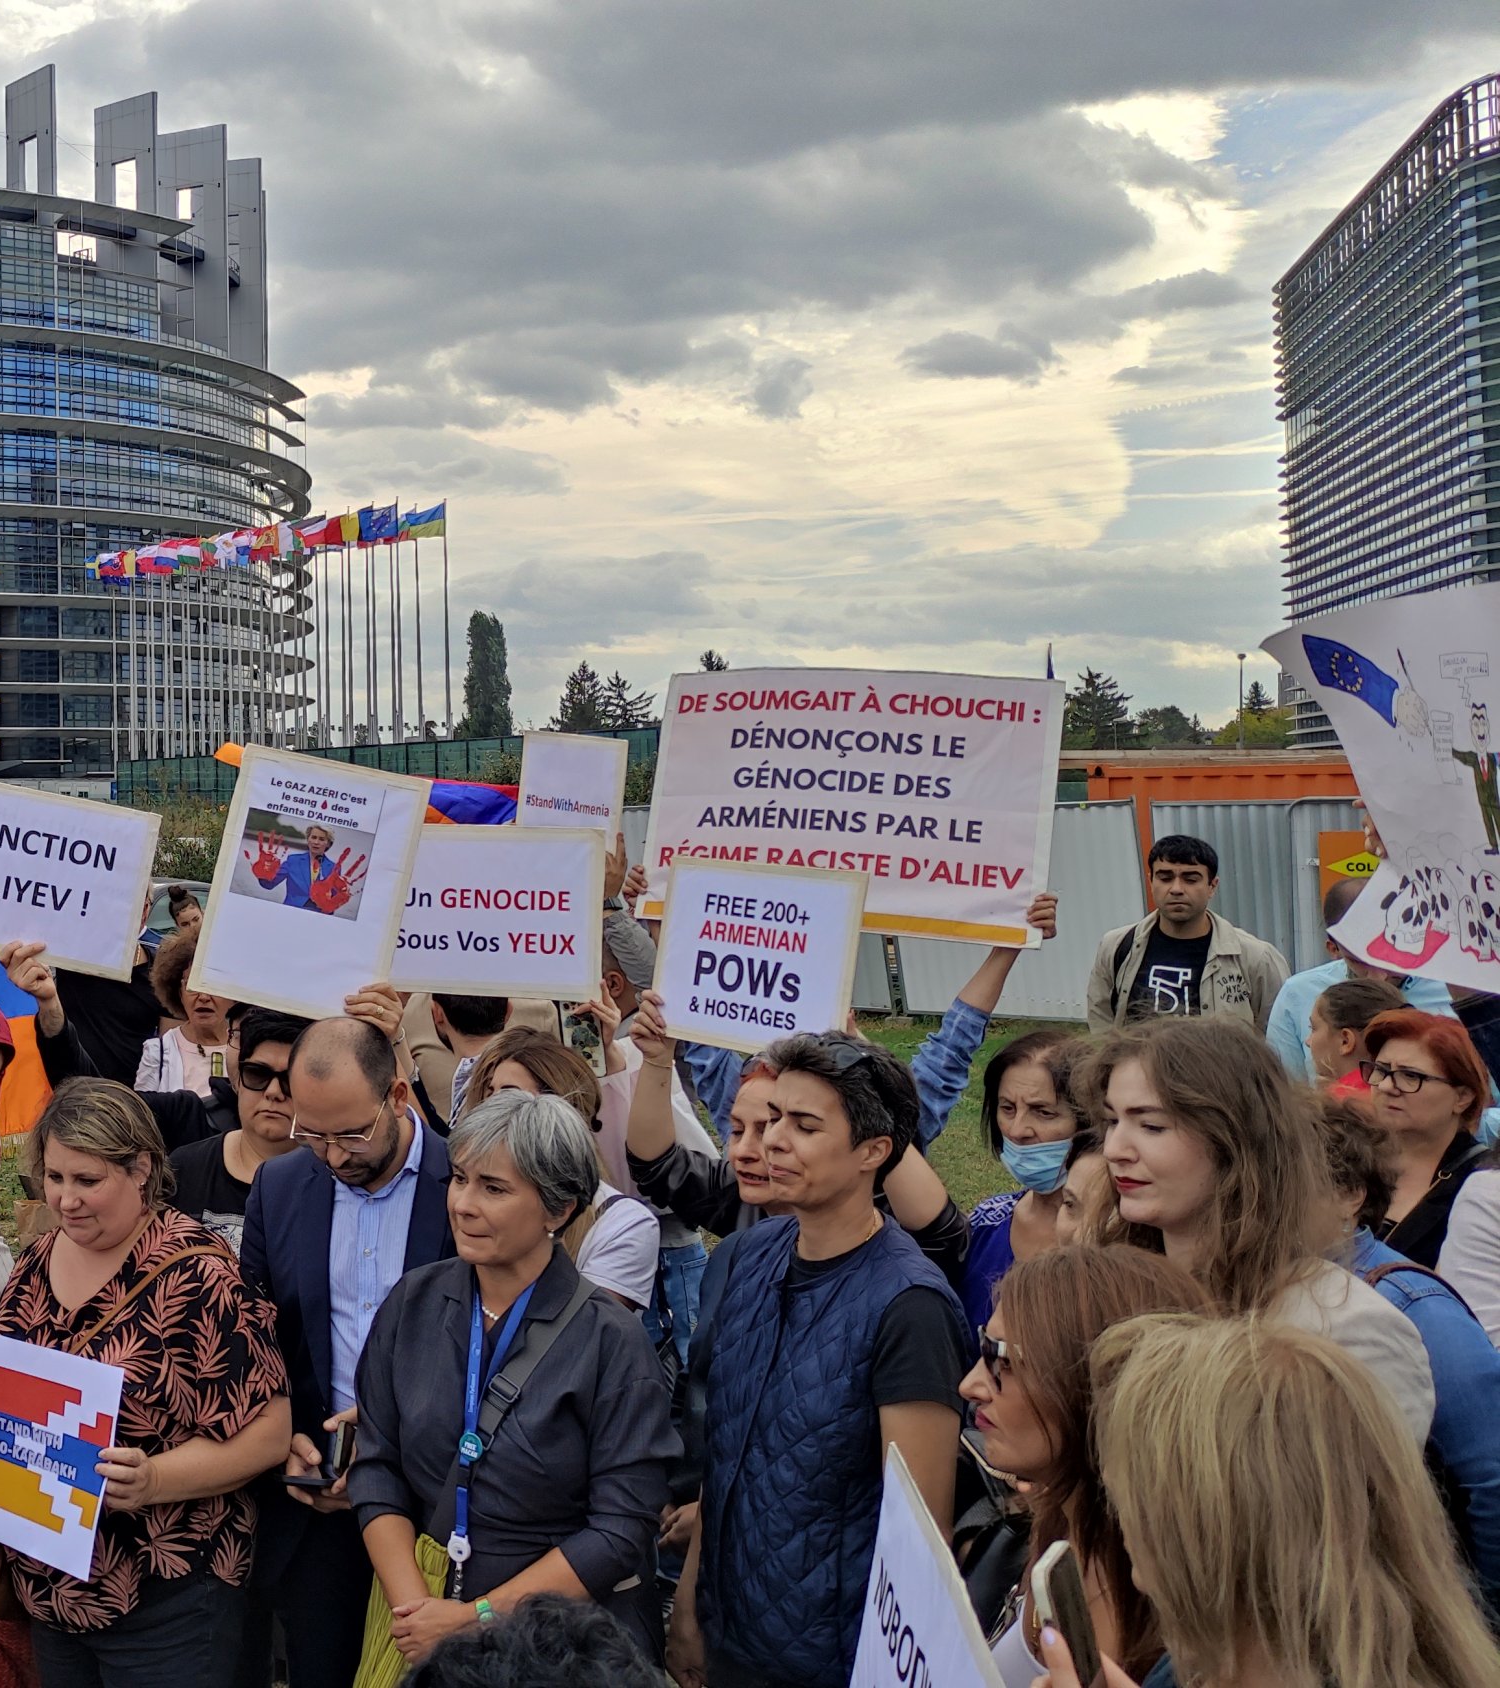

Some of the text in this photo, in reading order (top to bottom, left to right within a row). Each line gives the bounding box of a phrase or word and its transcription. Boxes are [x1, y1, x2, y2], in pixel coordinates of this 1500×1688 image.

[678, 693, 707, 715] DE
[712, 688, 856, 714] SOUMGAIT
[859, 684, 882, 714] À
[888, 692, 1026, 723] CHOUCHI
[730, 720, 966, 759] DÉNONÇONS LE
[270, 777, 283, 787] Le
[284, 779, 306, 793] GAZ
[307, 784, 338, 800] AZÉRI
[733, 760, 952, 800] GÉNOCIDE DES
[267, 801, 305, 817] enfants
[281, 791, 350, 814] le sang des
[525, 794, 610, 817] #StandWithArmenia
[697, 800, 983, 844] ARMÉNIENS PAR LE
[766, 847, 891, 878] RACISTE
[899, 857, 1025, 891] D'ALIEV
[1346, 861, 1378, 872] COL
[80, 890, 90, 917] !
[440, 887, 571, 912] GENOCIDE
[704, 893, 810, 926] FREE 200+
[396, 928, 576, 955] Sous Vos YEUX
[699, 920, 808, 954] ARMENIAN
[693, 950, 801, 1003] POWs
[689, 996, 796, 1031] & HOSTAGES
[31, 1429, 63, 1451] WITH
[874, 1556, 931, 1688] NOBOD
